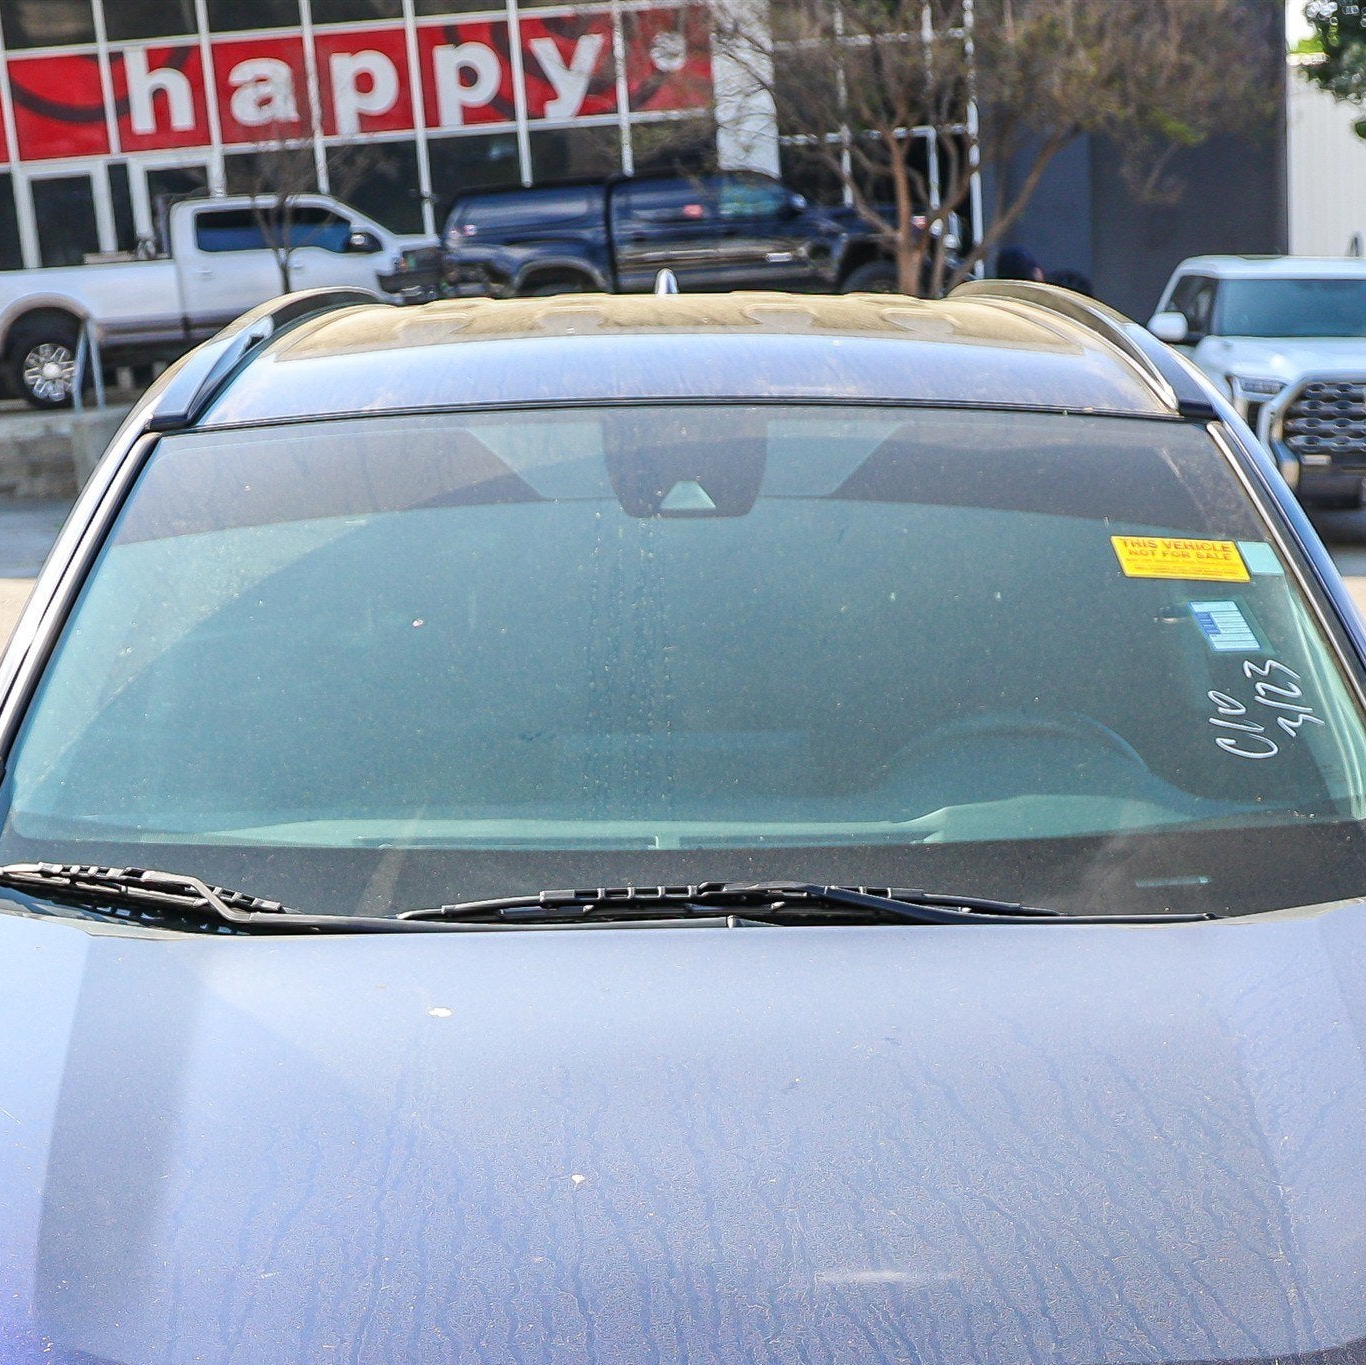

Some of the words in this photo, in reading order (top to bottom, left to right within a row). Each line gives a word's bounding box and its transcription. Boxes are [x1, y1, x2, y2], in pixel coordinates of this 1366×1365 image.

[123, 33, 605, 136] happy
[1122, 540, 1157, 548] THIS
[1164, 541, 1231, 552] VEHICLE
[1128, 549, 1156, 557] NOT
[1163, 550, 1191, 559] FOR
[1196, 551, 1232, 560] SALE
